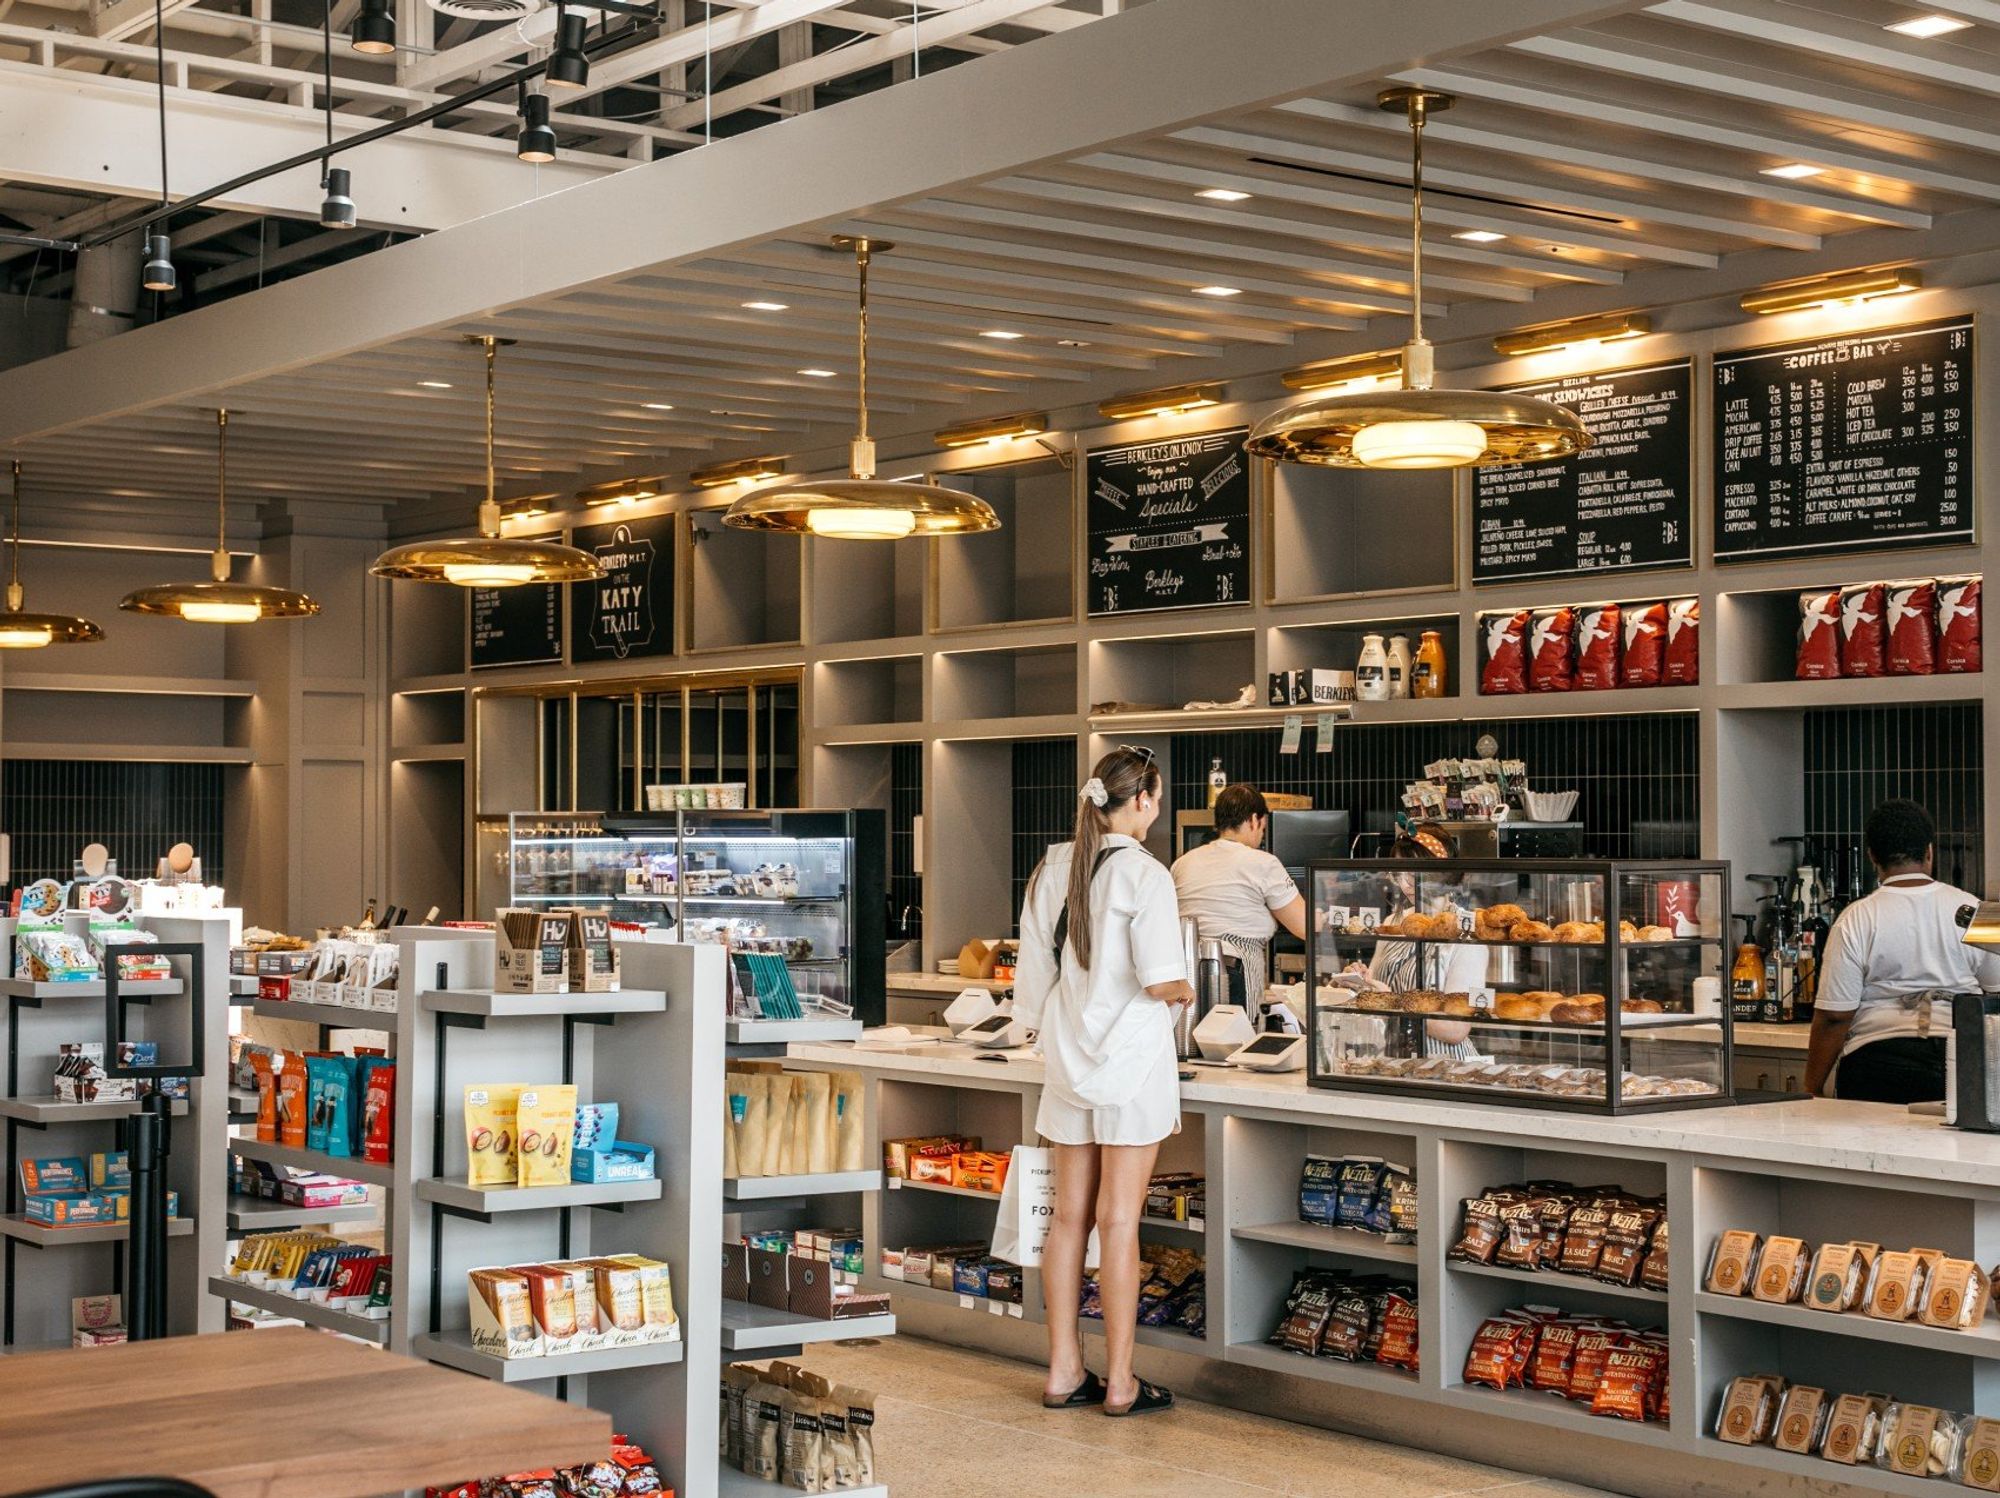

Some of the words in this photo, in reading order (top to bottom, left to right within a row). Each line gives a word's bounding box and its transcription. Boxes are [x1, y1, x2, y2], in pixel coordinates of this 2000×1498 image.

[1789, 350, 1834, 369] COFFEE
[1853, 344, 1874, 360] BAR
[1847, 381, 1866, 395] COLD
[1867, 378, 1886, 392] BREW
[1554, 384, 1614, 404] SANDWICHES
[1847, 394, 1873, 406] MATCHA
[1580, 399, 1605, 412] GRILLED
[1608, 396, 1629, 408] CHEESE
[1725, 398, 1749, 412] LATTE
[1725, 410, 1749, 423] MOCHA
[1846, 407, 1860, 419] HOT
[1862, 406, 1875, 417] TEA
[1725, 422, 1761, 436] AMERICANO
[1847, 420, 1862, 432] ICED
[1863, 418, 1876, 430] TEA
[1725, 437, 1741, 448] DRIP
[1743, 434, 1762, 447] COFFEE
[1847, 432, 1860, 445] HOT
[1170, 446, 1180, 459] ON
[1182, 441, 1203, 457] KNOX
[1725, 460, 1740, 472] CHAI
[1844, 460, 1852, 470] OF
[1854, 457, 1884, 469] ESPRESSO
[1579, 470, 1606, 482] ITALIAN
[1725, 483, 1756, 496] ESPRESSO
[1884, 480, 1917, 492] CHOCOLATE
[1905, 493, 1917, 502] SOY
[1139, 492, 1198, 524] Specials
[1725, 509, 1750, 521] CORTADO
[1829, 511, 1853, 522] CARAFE
[1131, 537, 1161, 550] STAPLES
[1168, 531, 1199, 546] CATERING
[1578, 558, 1596, 568] LARGE
[602, 585, 642, 610] KATY
[602, 611, 640, 634] TRAIL
[608, 1164, 641, 1178] UNREAL
[1608, 1351, 1654, 1369] KETTLE
